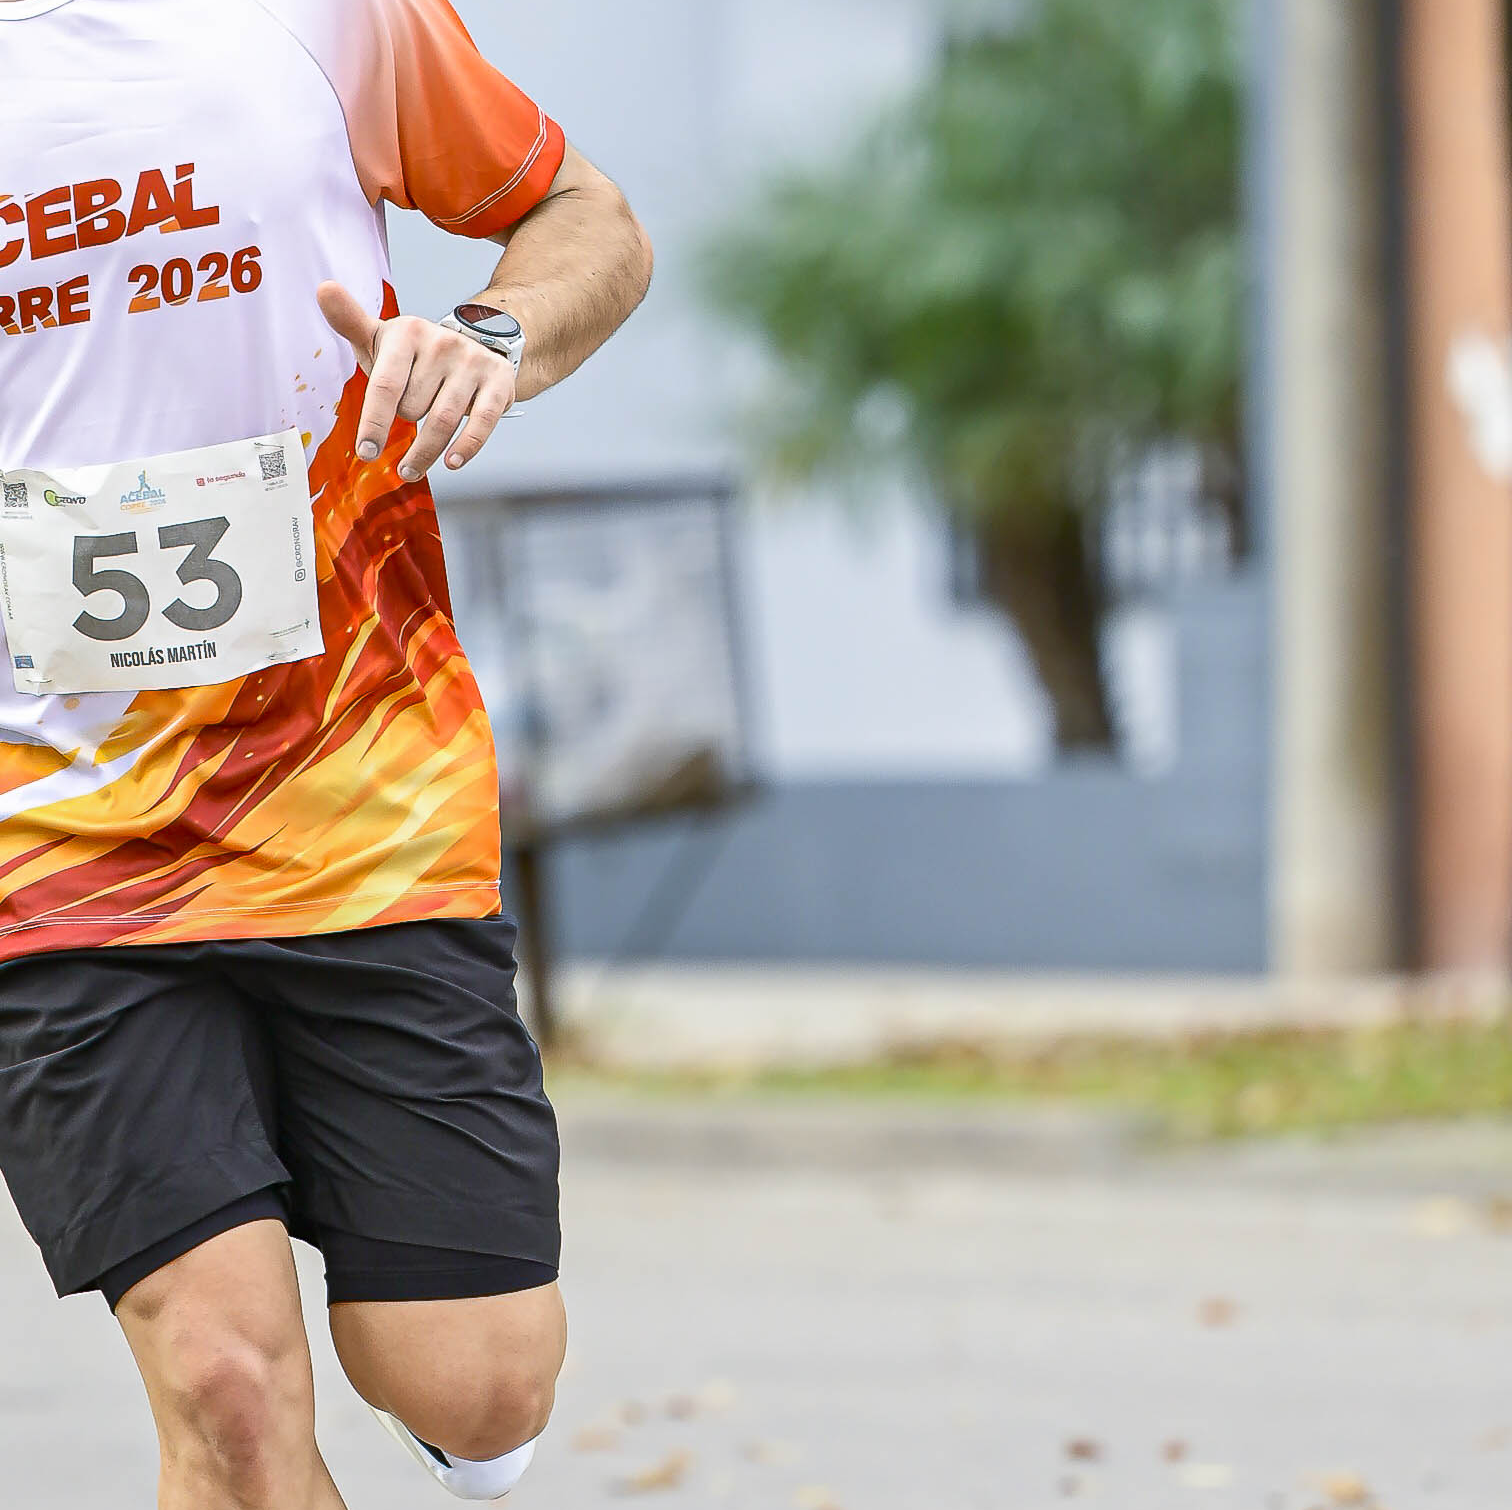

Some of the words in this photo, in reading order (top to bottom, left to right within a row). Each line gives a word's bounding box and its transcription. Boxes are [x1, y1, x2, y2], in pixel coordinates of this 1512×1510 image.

[126, 245, 263, 314] 2026
[72, 515, 243, 642] 53
[109, 646, 165, 668] NICOLÁS
[166, 639, 217, 664] MARTÍN
